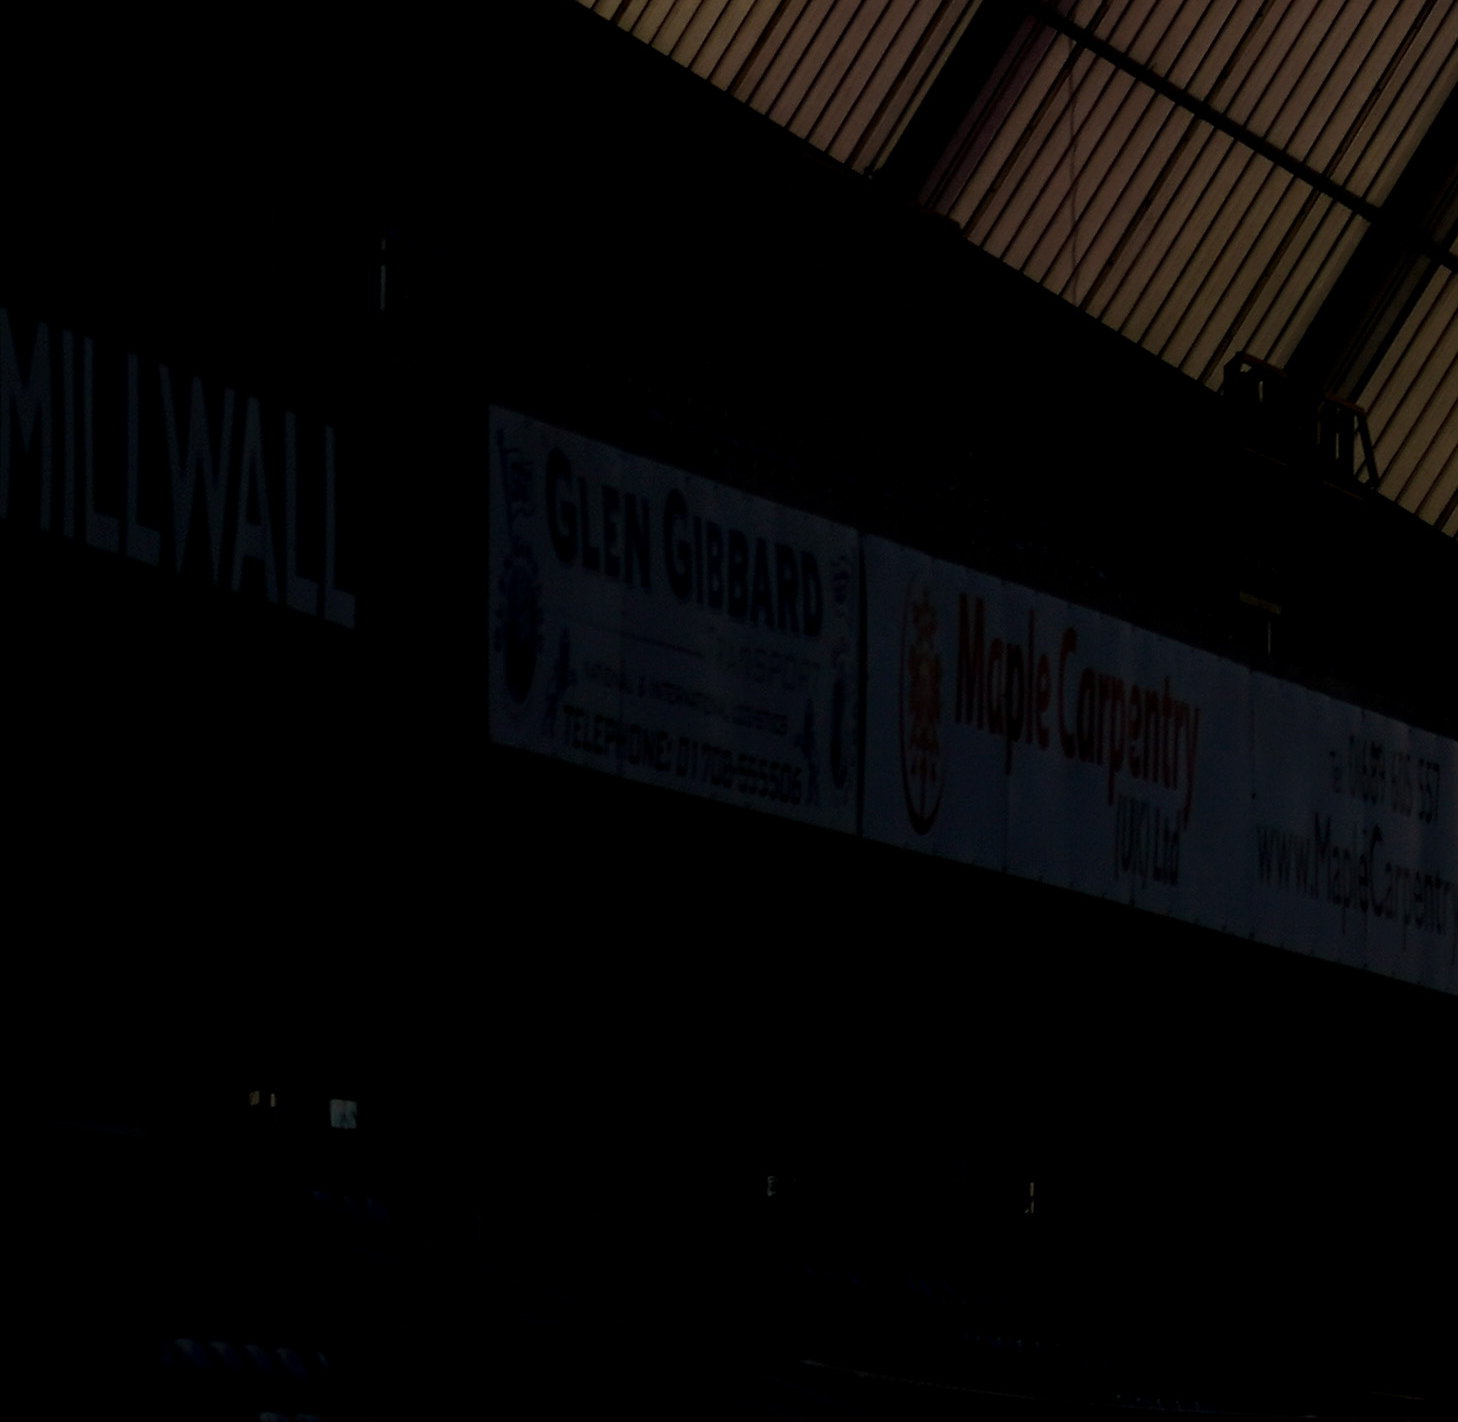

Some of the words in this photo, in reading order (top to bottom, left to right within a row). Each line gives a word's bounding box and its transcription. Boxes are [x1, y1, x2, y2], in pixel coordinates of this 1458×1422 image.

[0, 308, 357, 630] MILLWALL
[545, 445, 653, 591] GLEN
[662, 487, 825, 639] GIBBARD
[562, 703, 673, 772] TELEPHONE:
[953, 591, 1052, 777] Maple
[1057, 625, 1202, 832] Carpentry
[1113, 790, 1150, 890] (UK)
[1152, 804, 1183, 888] Ltd
